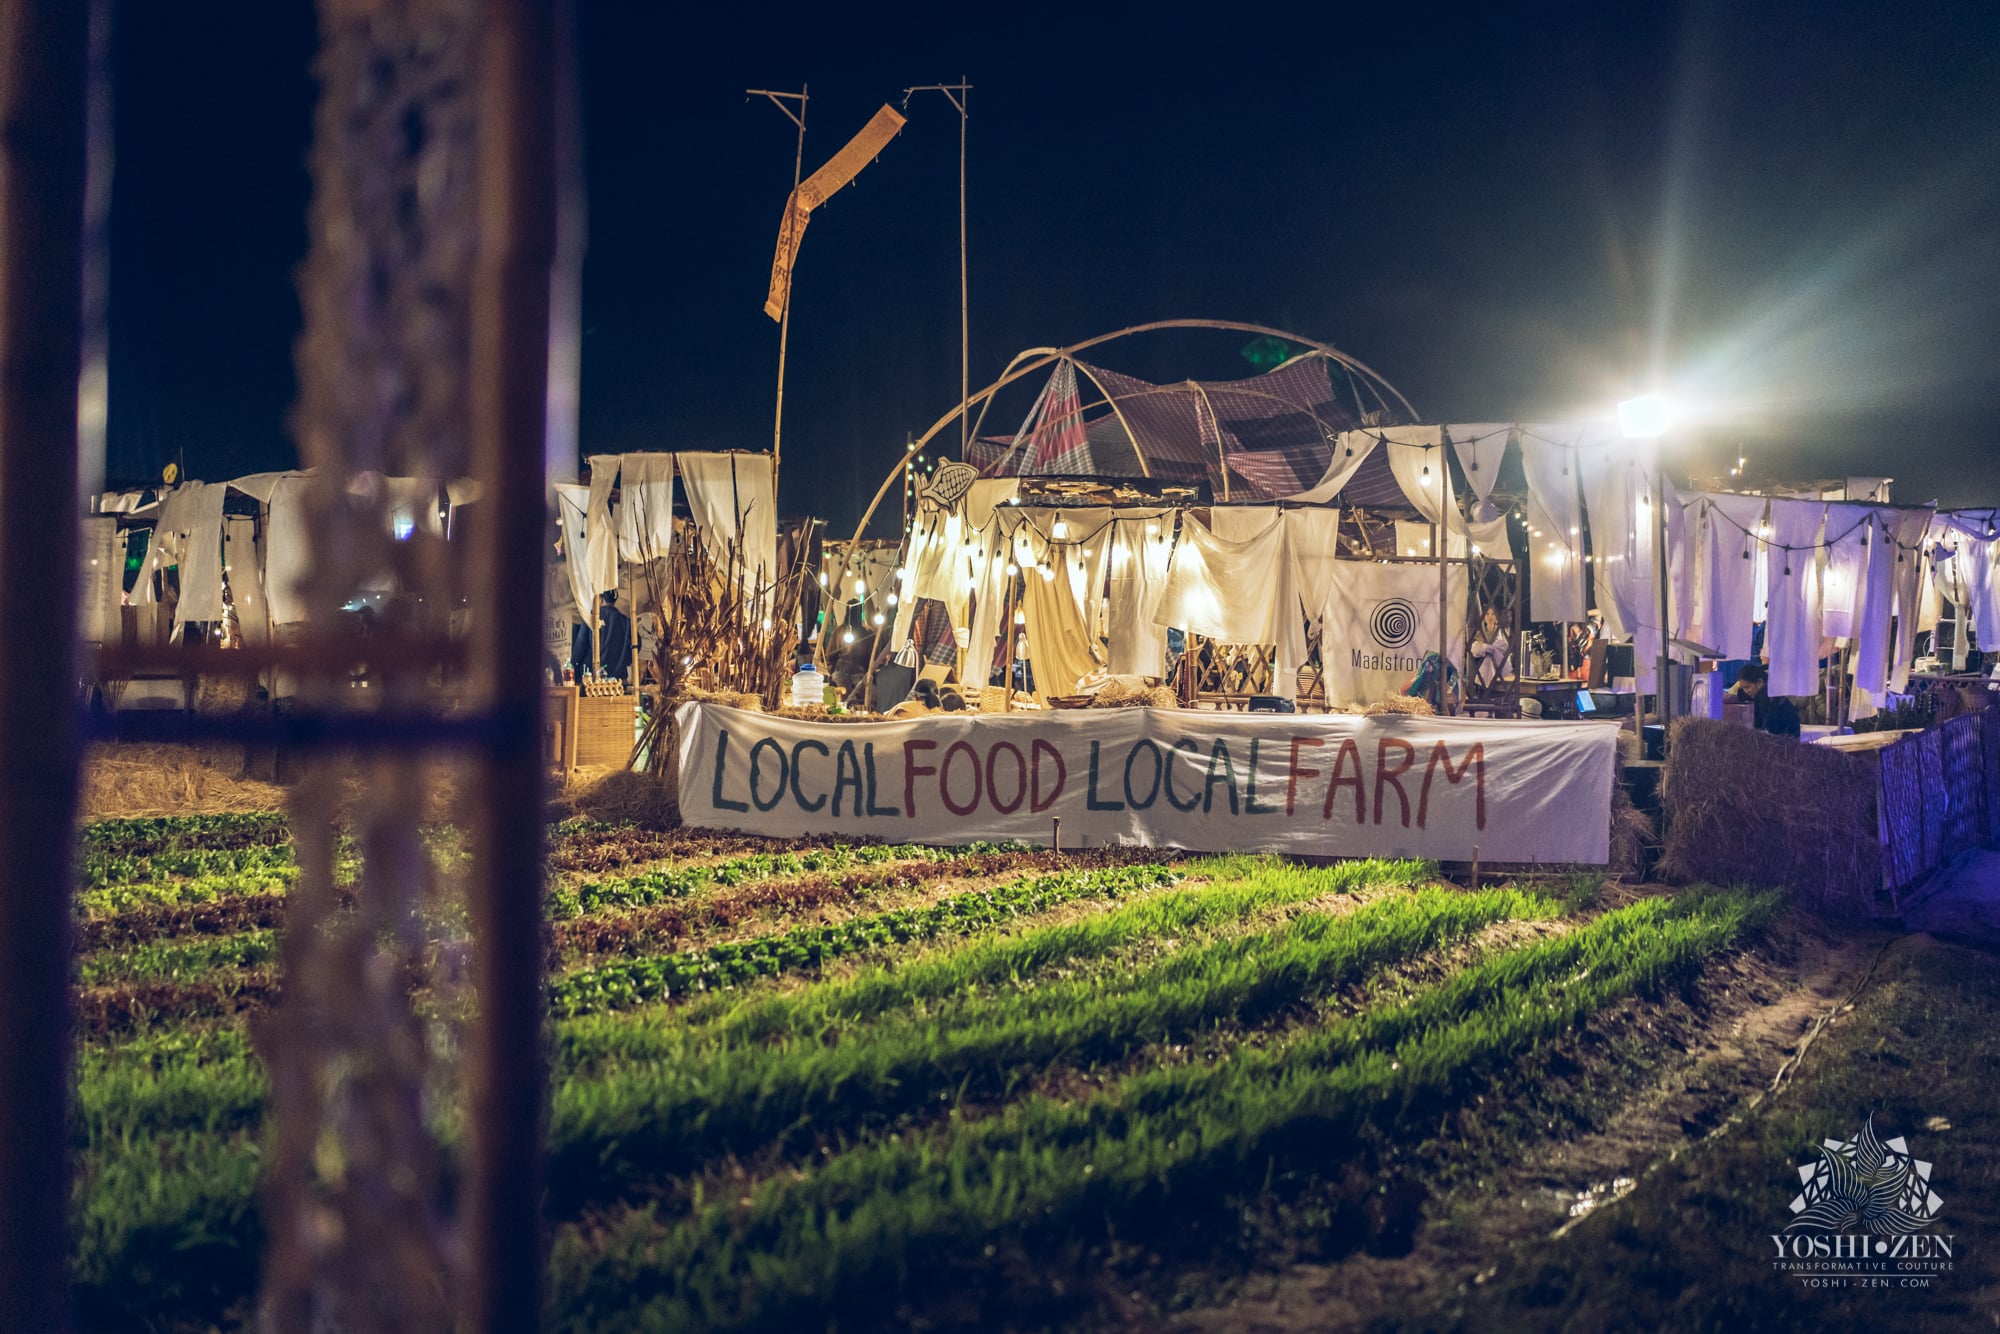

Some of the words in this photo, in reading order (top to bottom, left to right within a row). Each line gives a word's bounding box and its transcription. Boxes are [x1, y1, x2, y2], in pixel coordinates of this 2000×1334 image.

[712, 729, 899, 817] LOCAL
[903, 738, 1067, 818] FOOD
[1086, 736, 1280, 816] LOCAL
[1285, 735, 1486, 830] FARM
